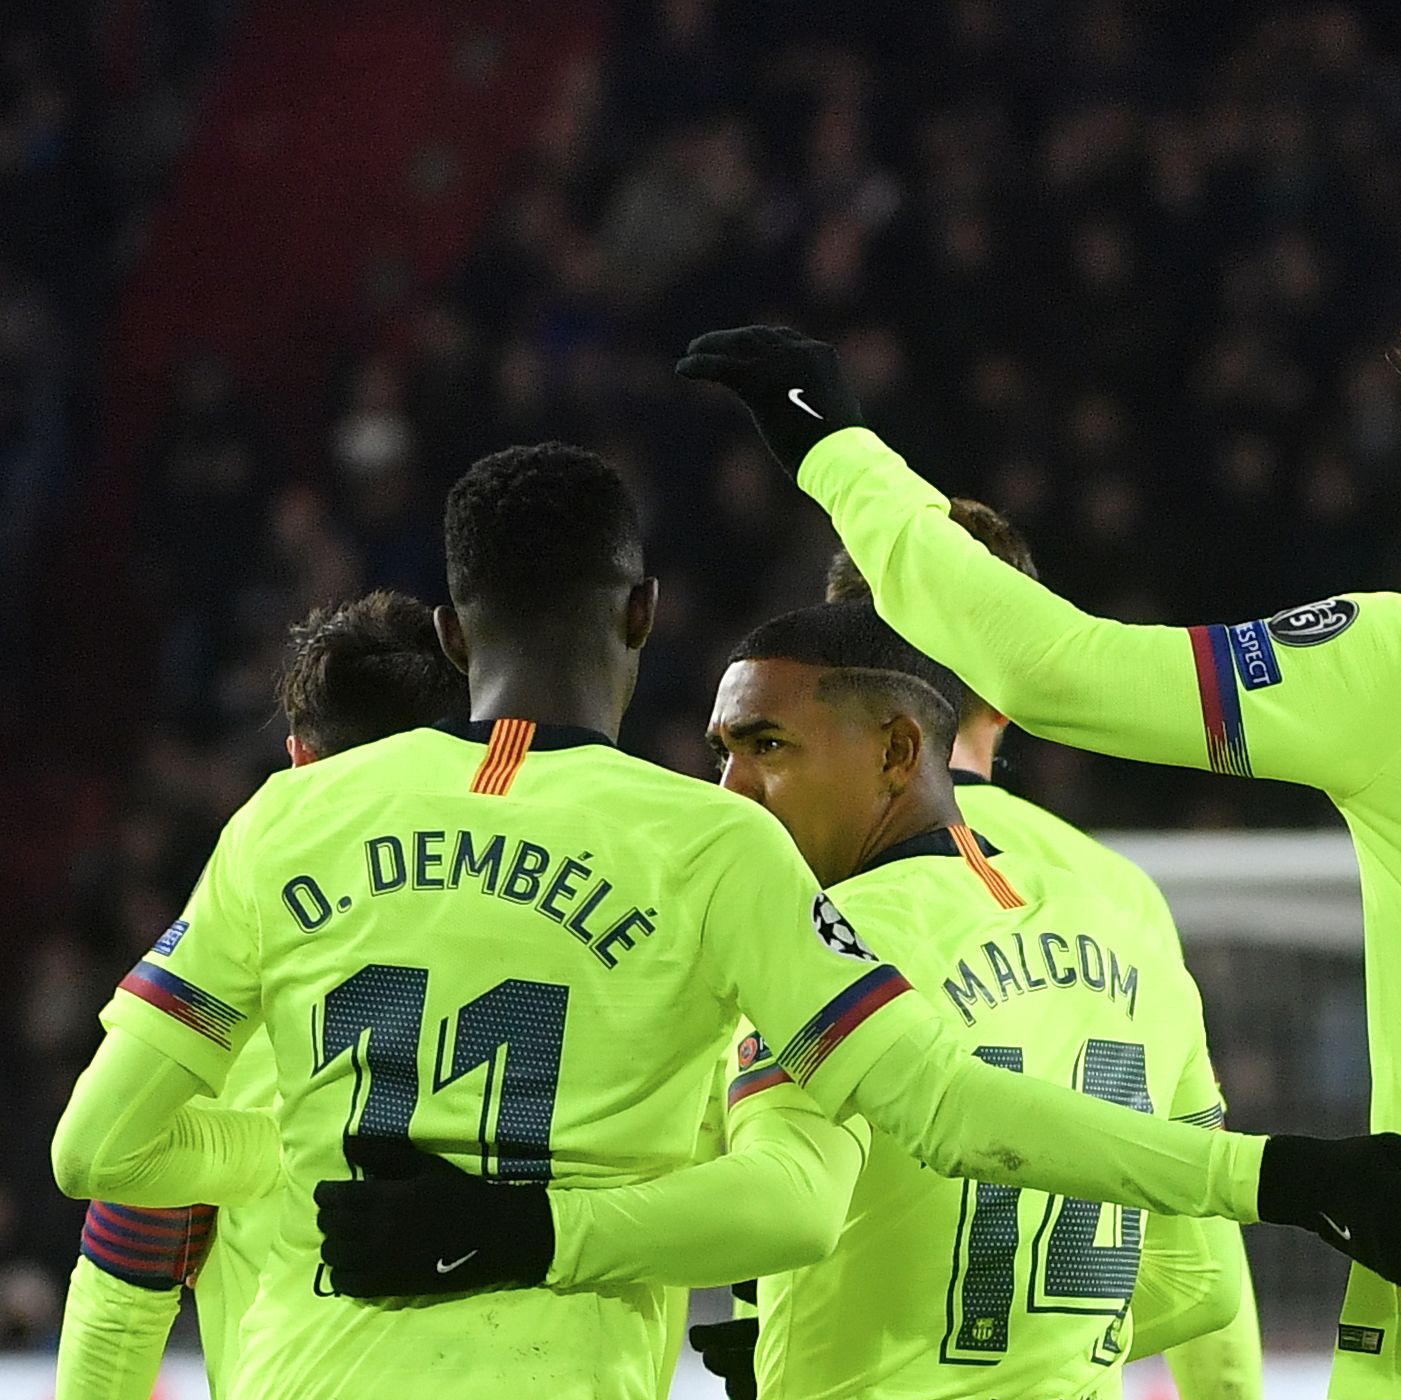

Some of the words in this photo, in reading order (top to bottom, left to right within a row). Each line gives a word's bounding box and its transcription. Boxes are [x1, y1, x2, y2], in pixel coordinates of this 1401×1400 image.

[1235, 624, 1271, 684] ESPECT
[281, 874, 352, 933] O.
[364, 830, 657, 969] DEMBÉLÉ
[942, 932, 1138, 1026] MALCOM
[311, 964, 571, 1185] 11
